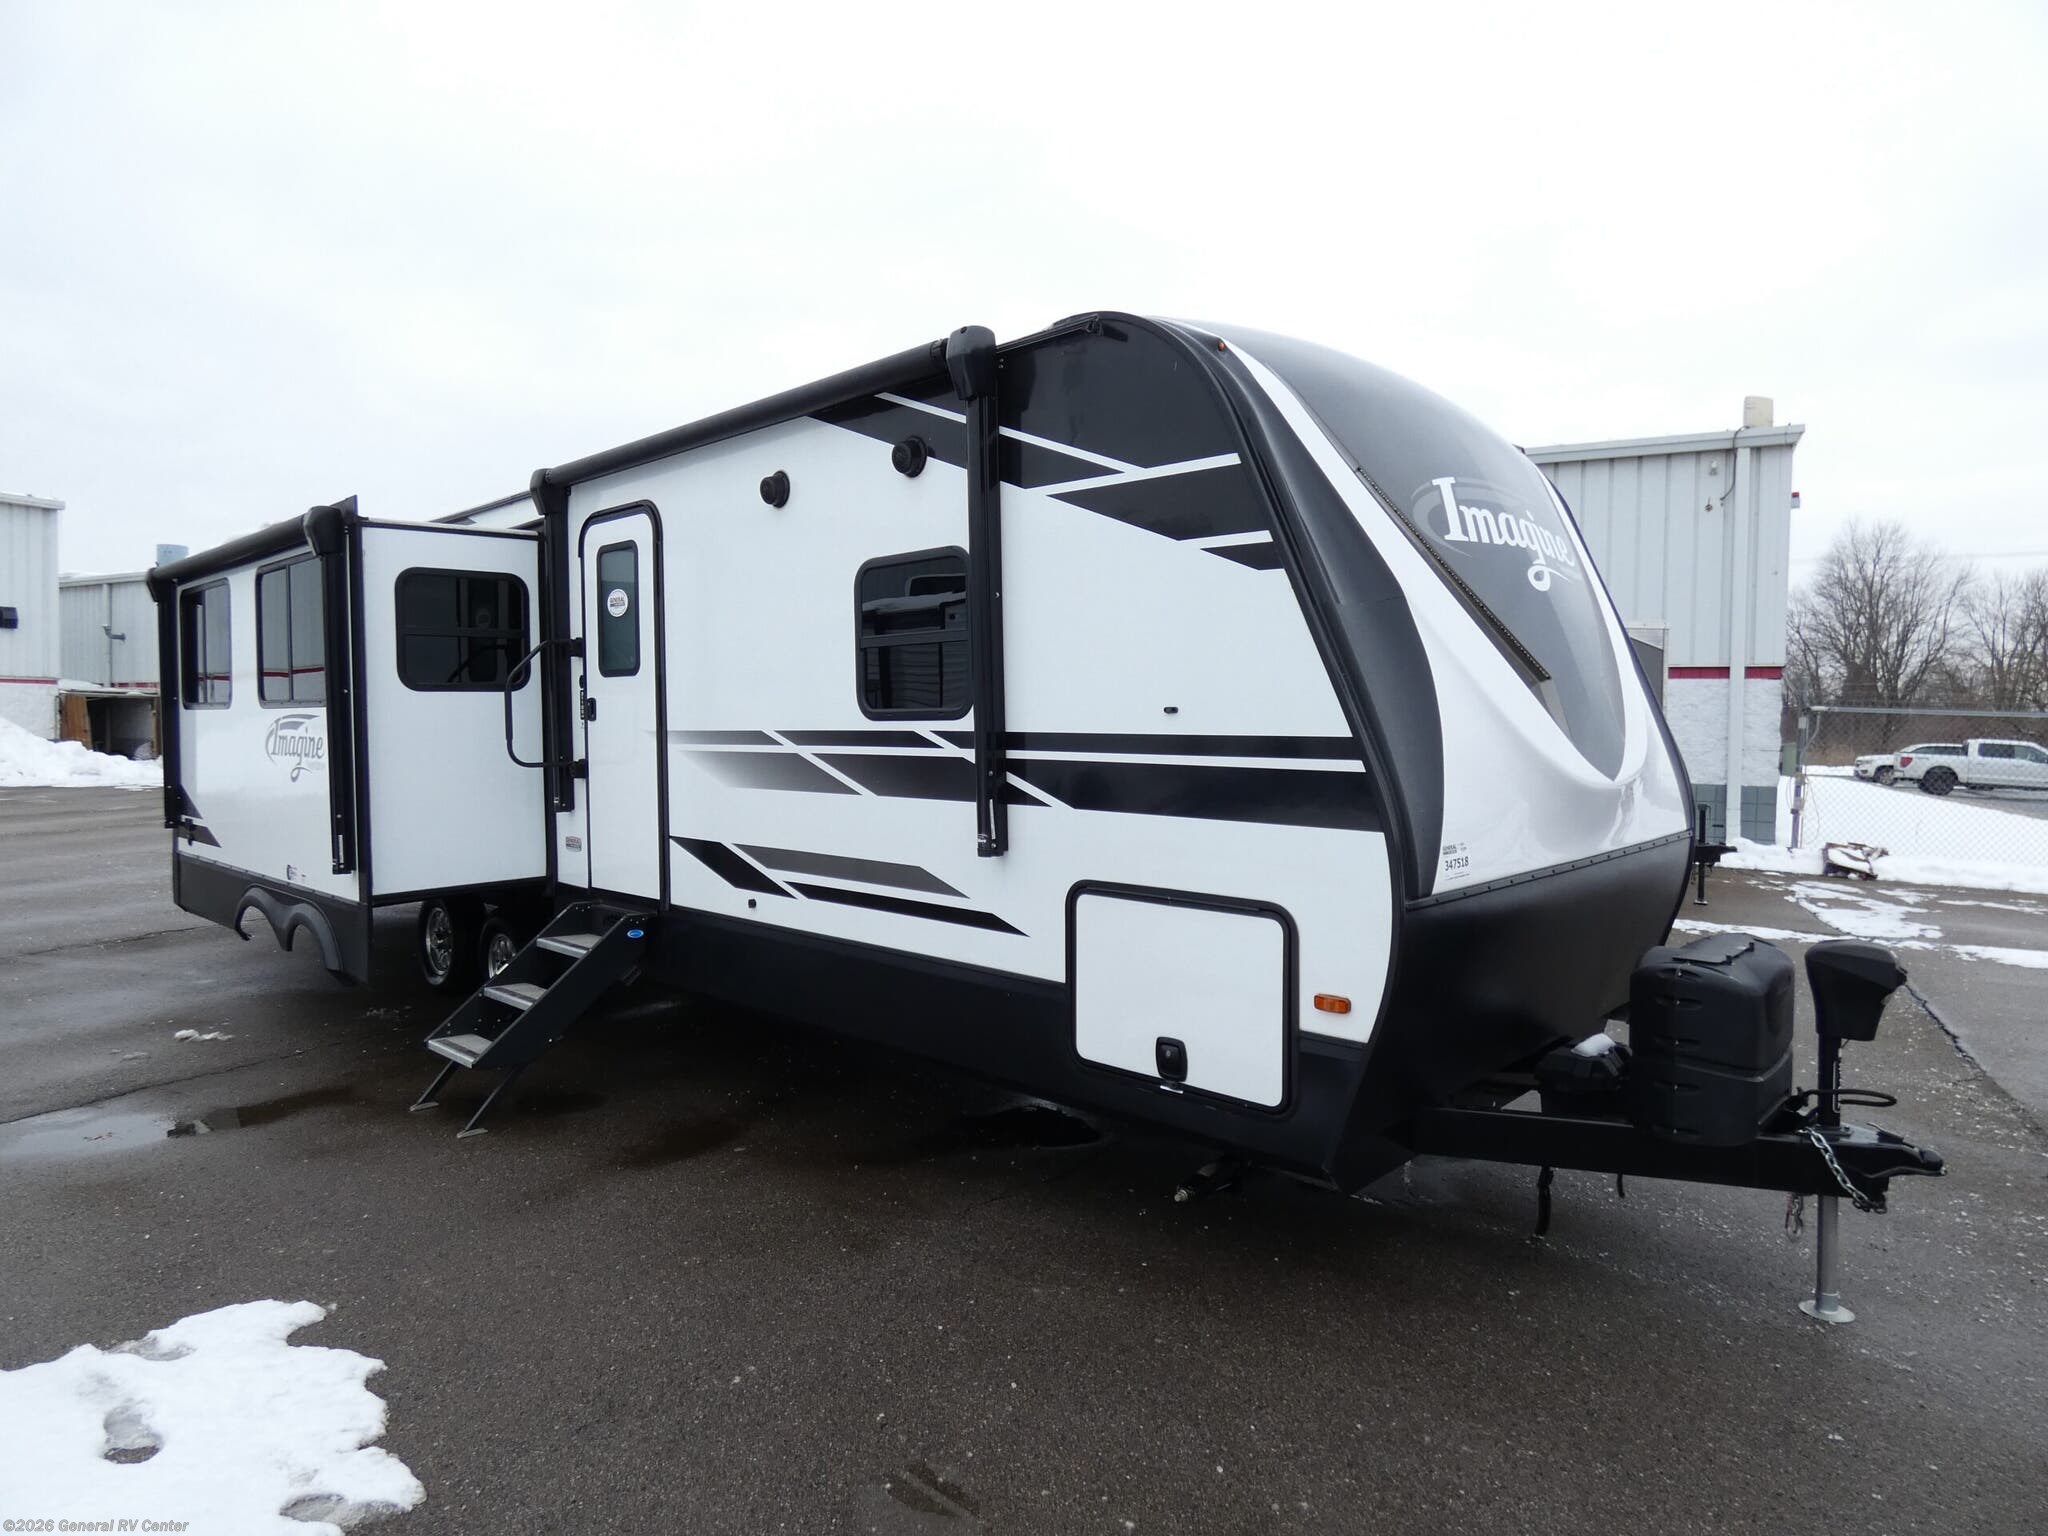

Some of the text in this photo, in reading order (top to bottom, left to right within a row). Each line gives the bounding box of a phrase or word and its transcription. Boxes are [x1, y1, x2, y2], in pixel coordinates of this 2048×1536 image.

[1432, 477, 1575, 591] Imagine
[271, 719, 324, 782] Imagine
[1445, 856, 1469, 871] 347518
